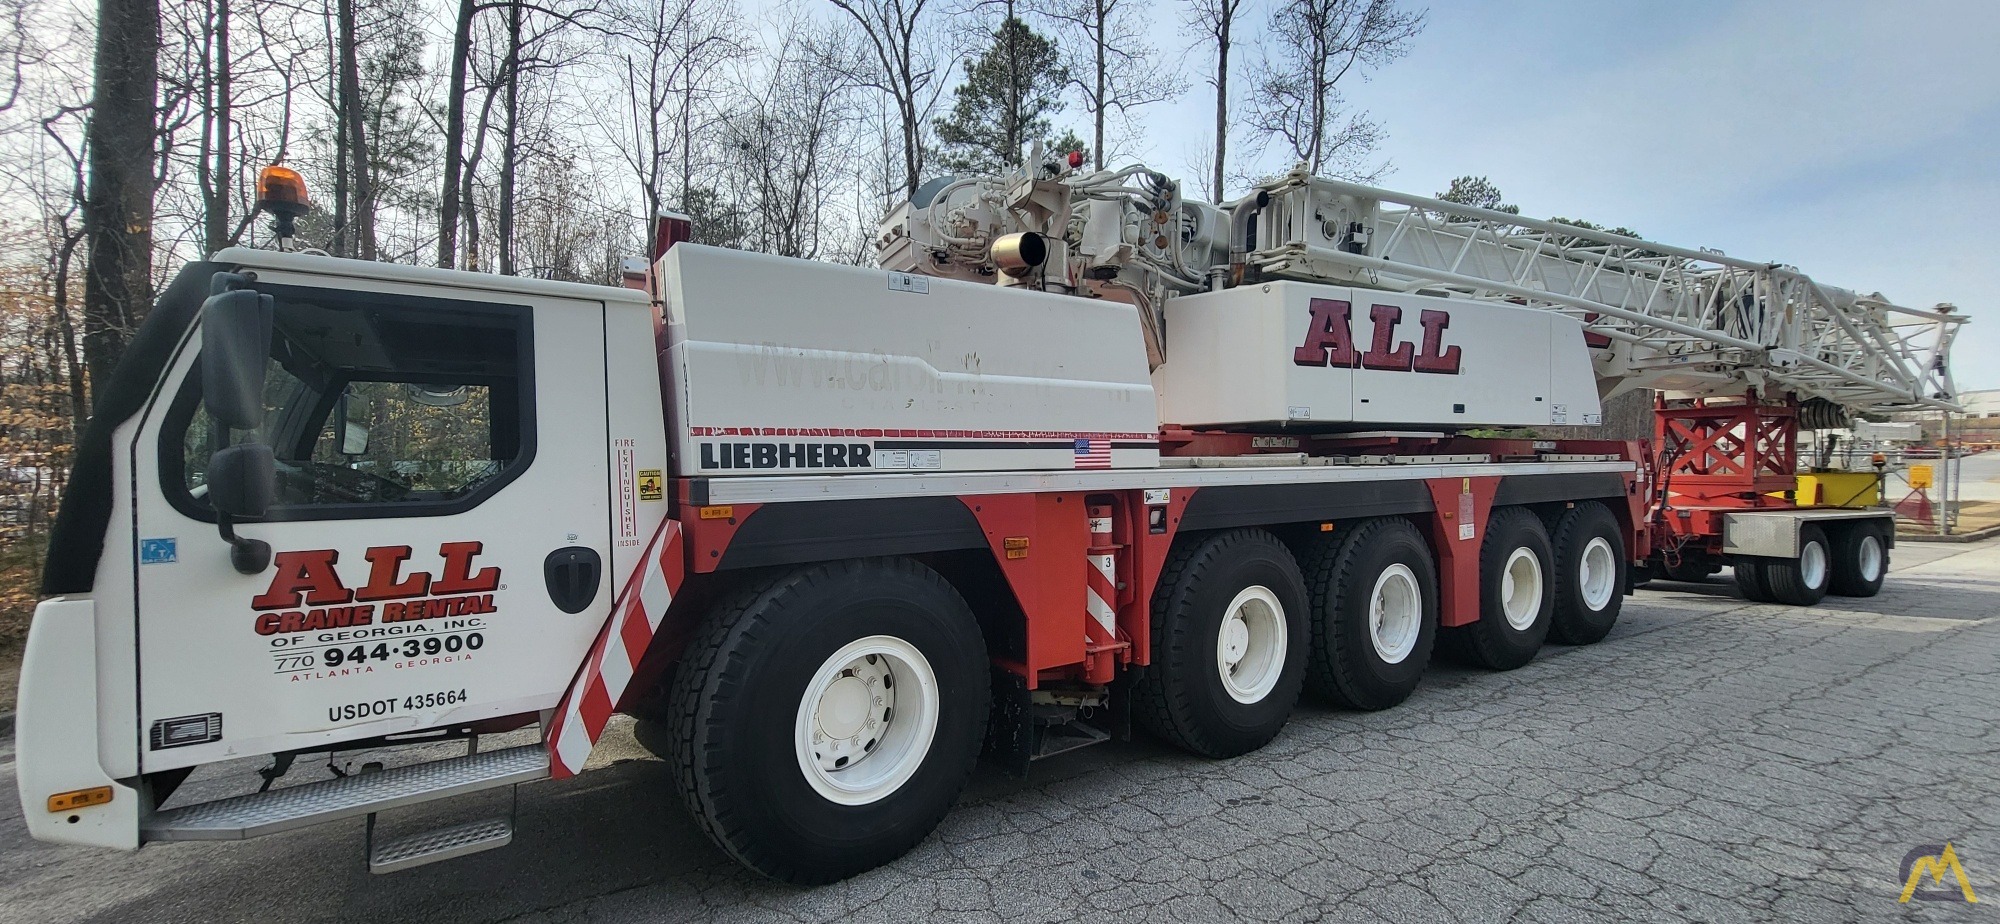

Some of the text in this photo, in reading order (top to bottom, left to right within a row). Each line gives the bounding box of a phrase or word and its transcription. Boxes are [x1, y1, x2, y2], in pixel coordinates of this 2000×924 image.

[1294, 297, 1462, 375] ALL
[614, 439, 635, 447] FIRE
[700, 443, 871, 469] LIEBHERR
[622, 449, 632, 537] EXTINGUISHER
[617, 539, 640, 547] INSIDE
[251, 541, 501, 611] ALL
[1105, 557, 1111, 568] 3
[254, 594, 498, 636] CRANE RENTAL
[270, 618, 487, 648] OF GEORGIA, INC.
[274, 655, 315, 670] 770
[290, 653, 472, 682] ATLANTA GEORGIA
[328, 688, 467, 722] USDOT 435664
